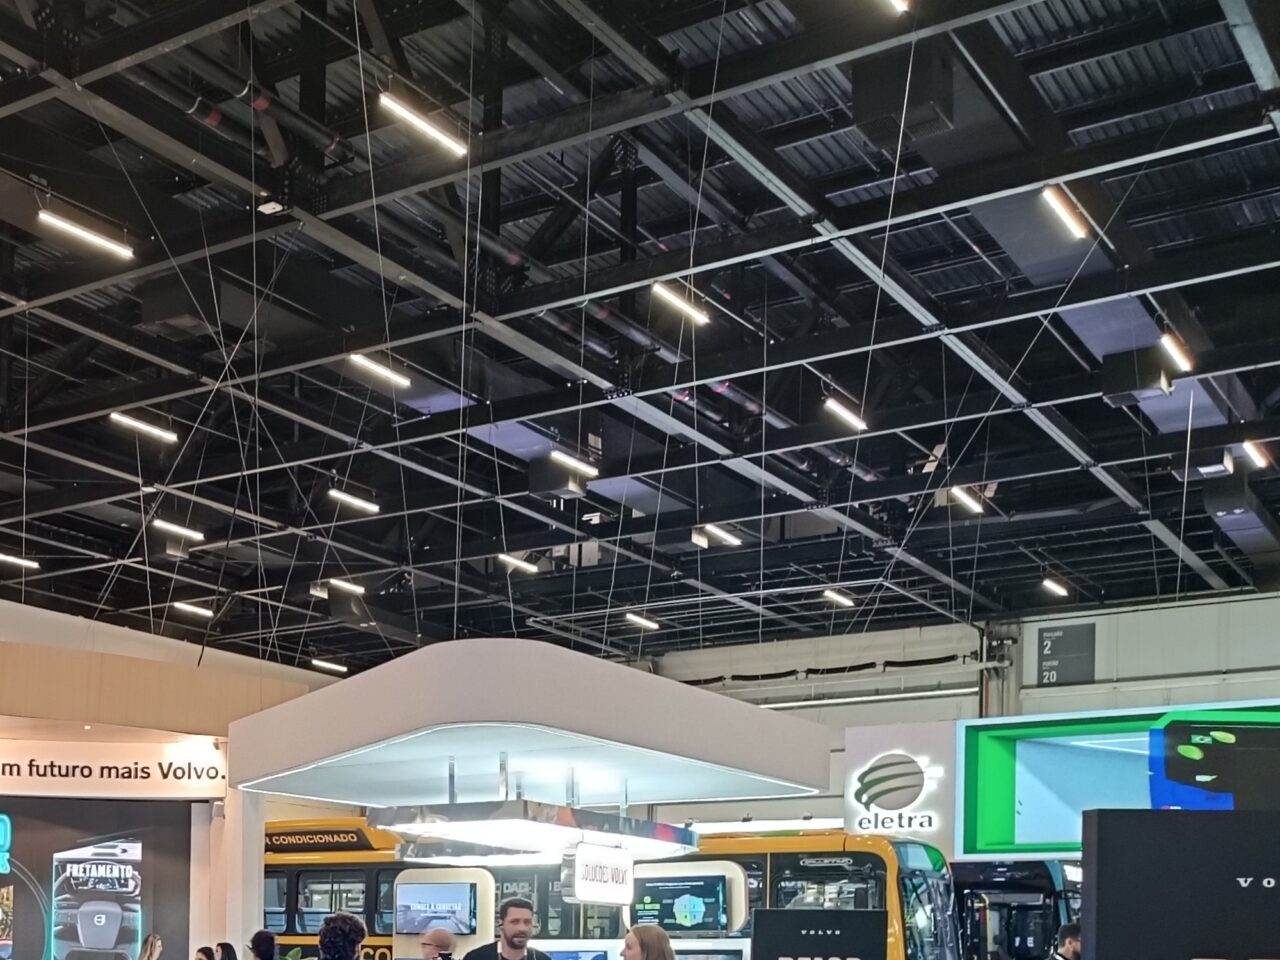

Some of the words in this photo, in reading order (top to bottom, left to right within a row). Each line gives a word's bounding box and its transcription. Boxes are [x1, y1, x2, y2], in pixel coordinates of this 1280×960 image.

[1043, 640, 1051, 655] 2
[1042, 671, 1057, 683] 20
[27, 758, 93, 779] futuro
[99, 762, 151, 780] mais
[158, 762, 226, 781] Volvo.
[858, 812, 932, 829] eletra
[272, 833, 357, 845] CONDICIONADO
[66, 863, 133, 878] FRETAMENTO
